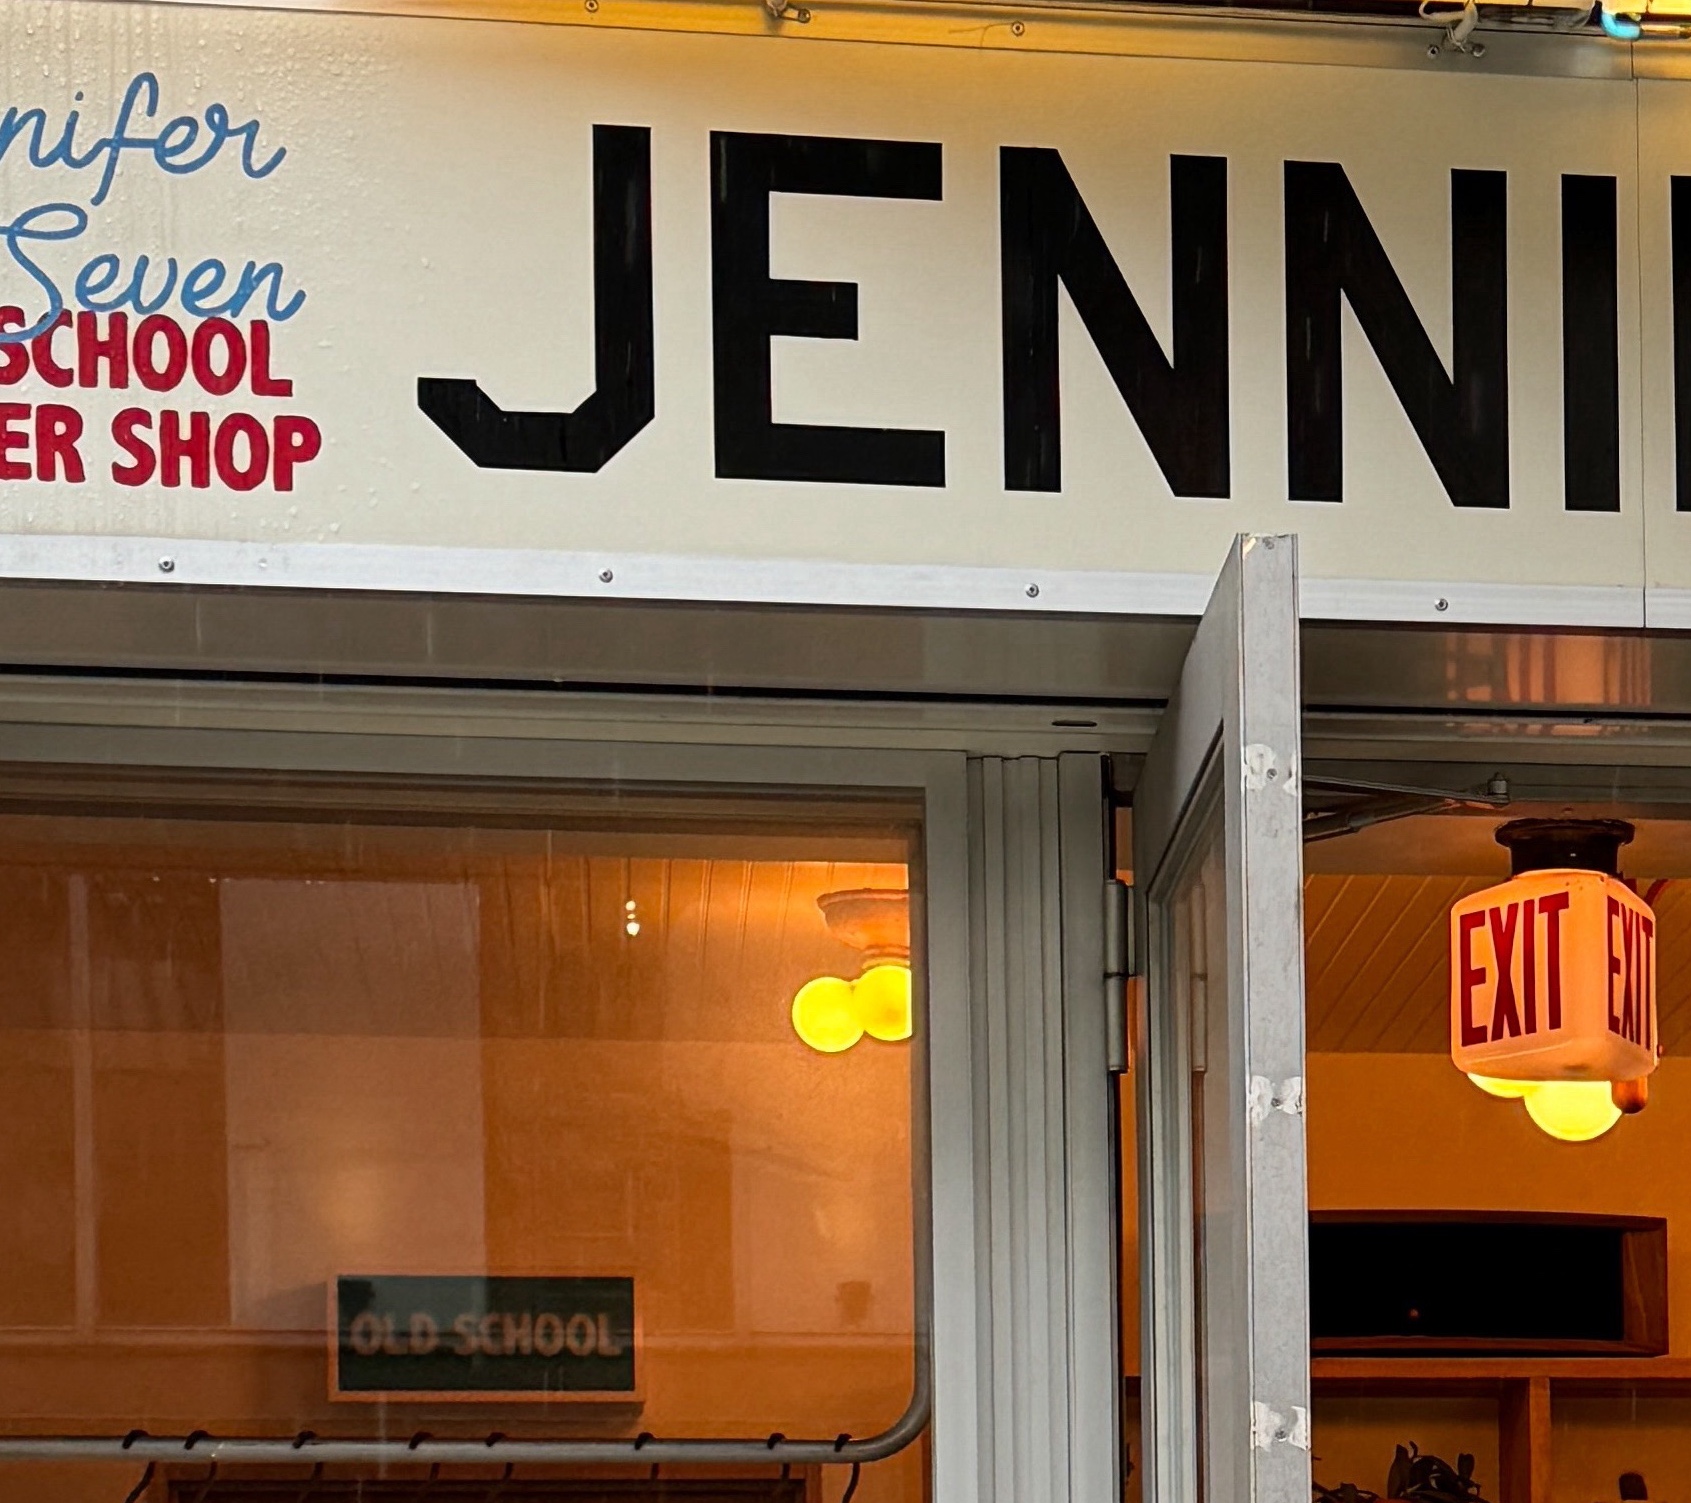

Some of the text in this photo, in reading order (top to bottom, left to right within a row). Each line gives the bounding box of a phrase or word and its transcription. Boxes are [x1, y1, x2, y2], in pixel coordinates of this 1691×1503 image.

[0, 202, 307, 344] Seven
[0, 402, 322, 491] ER SHOP
[1460, 891, 1654, 1052] EXIT EXIT
[351, 1311, 623, 1357] OLD SCHOOL
